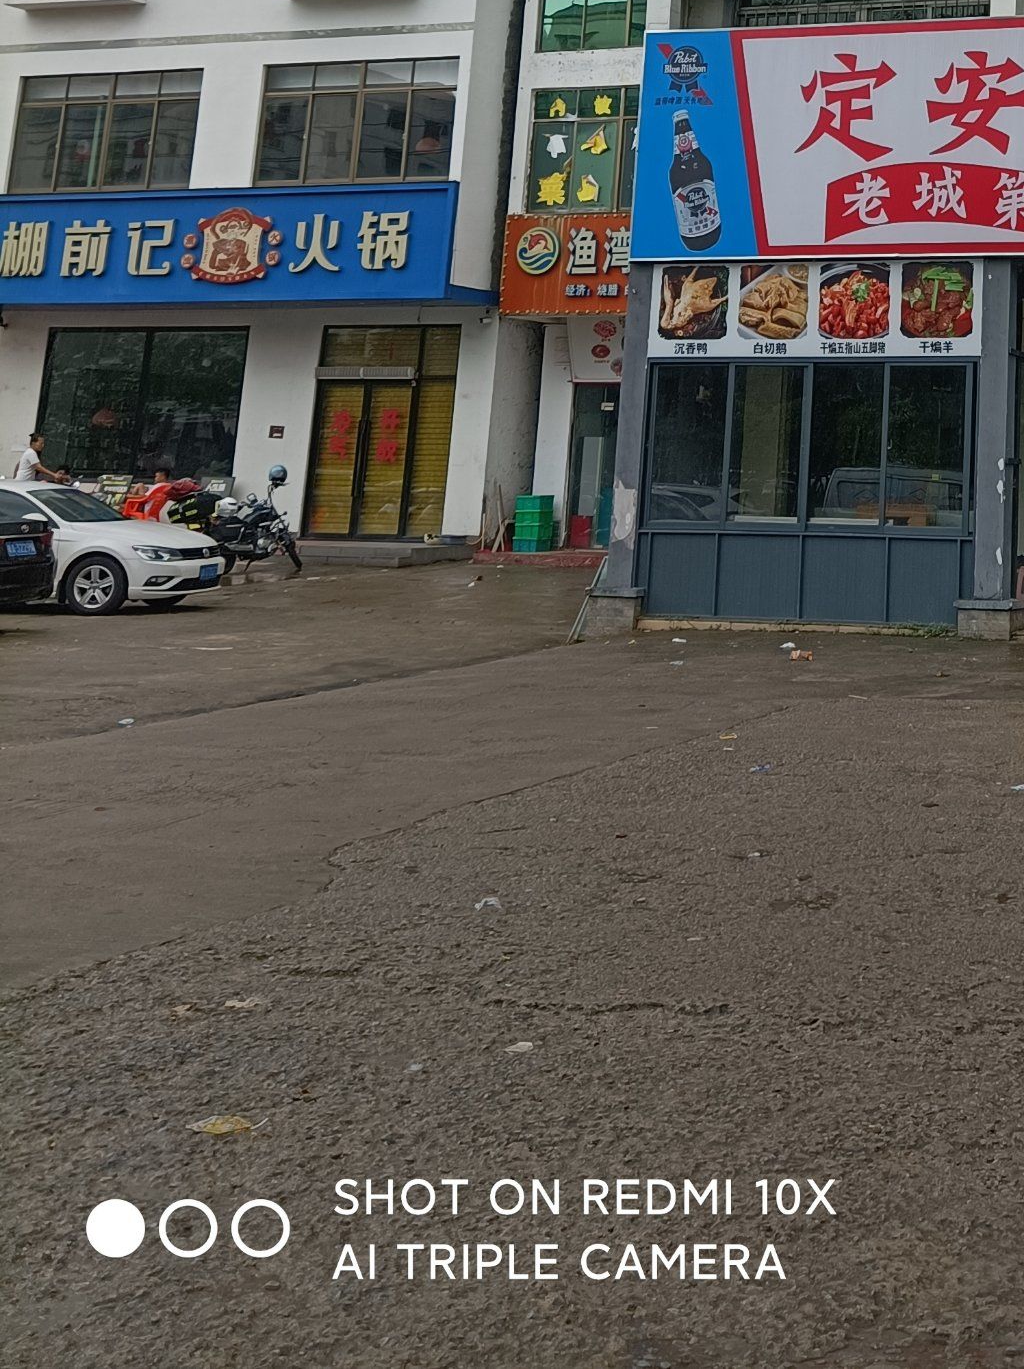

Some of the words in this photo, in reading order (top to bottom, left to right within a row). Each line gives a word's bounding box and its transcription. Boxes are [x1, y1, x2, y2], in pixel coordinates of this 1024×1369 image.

[673, 51, 698, 63] Pabst
[664, 65, 680, 74] Blue
[681, 64, 707, 73] Ribbon
[0, 219, 177, 277] 棚前记
[288, 209, 412, 273] 火锅
[674, 342, 708, 355] 沉香鸭
[753, 342, 787, 355] 白切鹅
